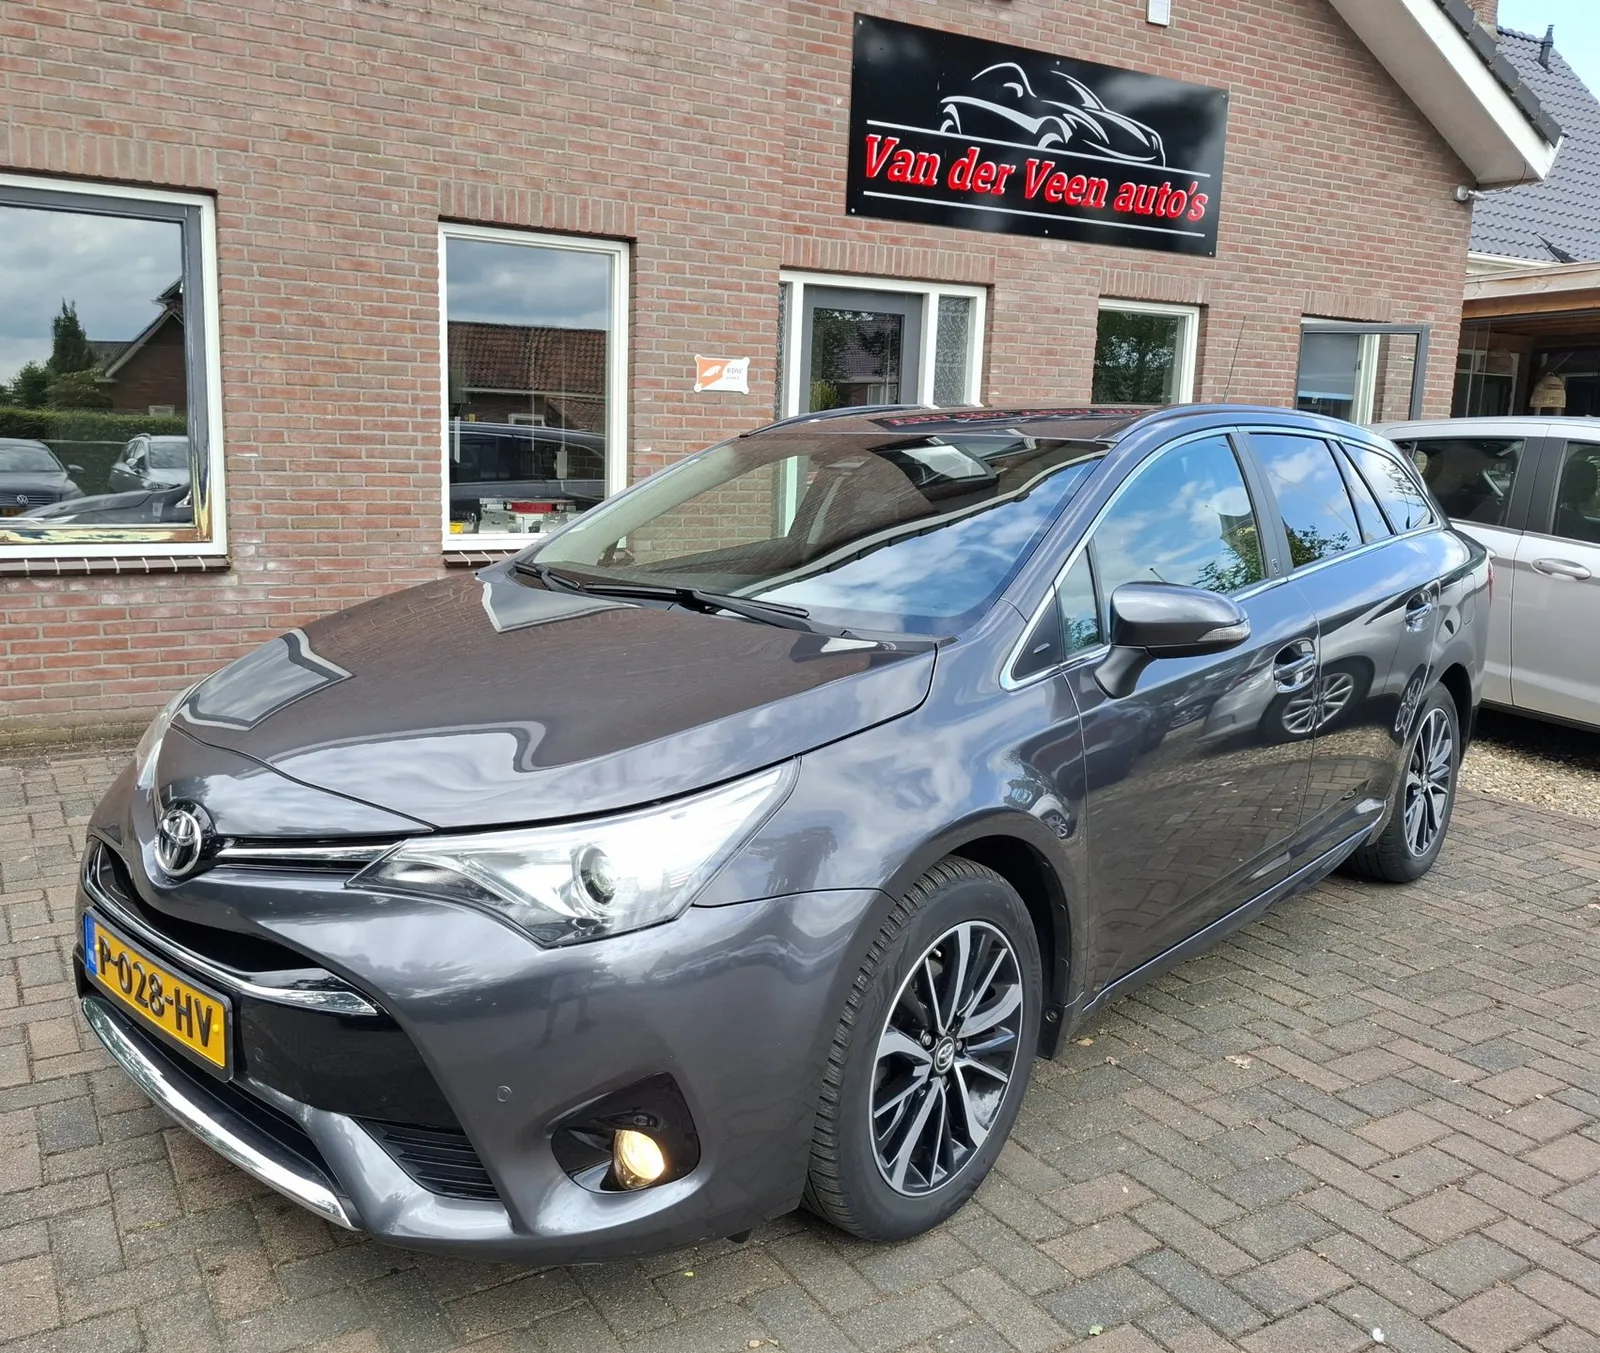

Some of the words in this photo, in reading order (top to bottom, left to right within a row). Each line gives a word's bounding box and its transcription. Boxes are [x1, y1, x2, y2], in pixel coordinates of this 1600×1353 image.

[865, 134, 941, 186] Van
[948, 147, 1014, 196] der
[1025, 159, 1109, 208] Veen
[1114, 182, 1208, 221] auto's
[98, 935, 213, 1048] P-028-HV
